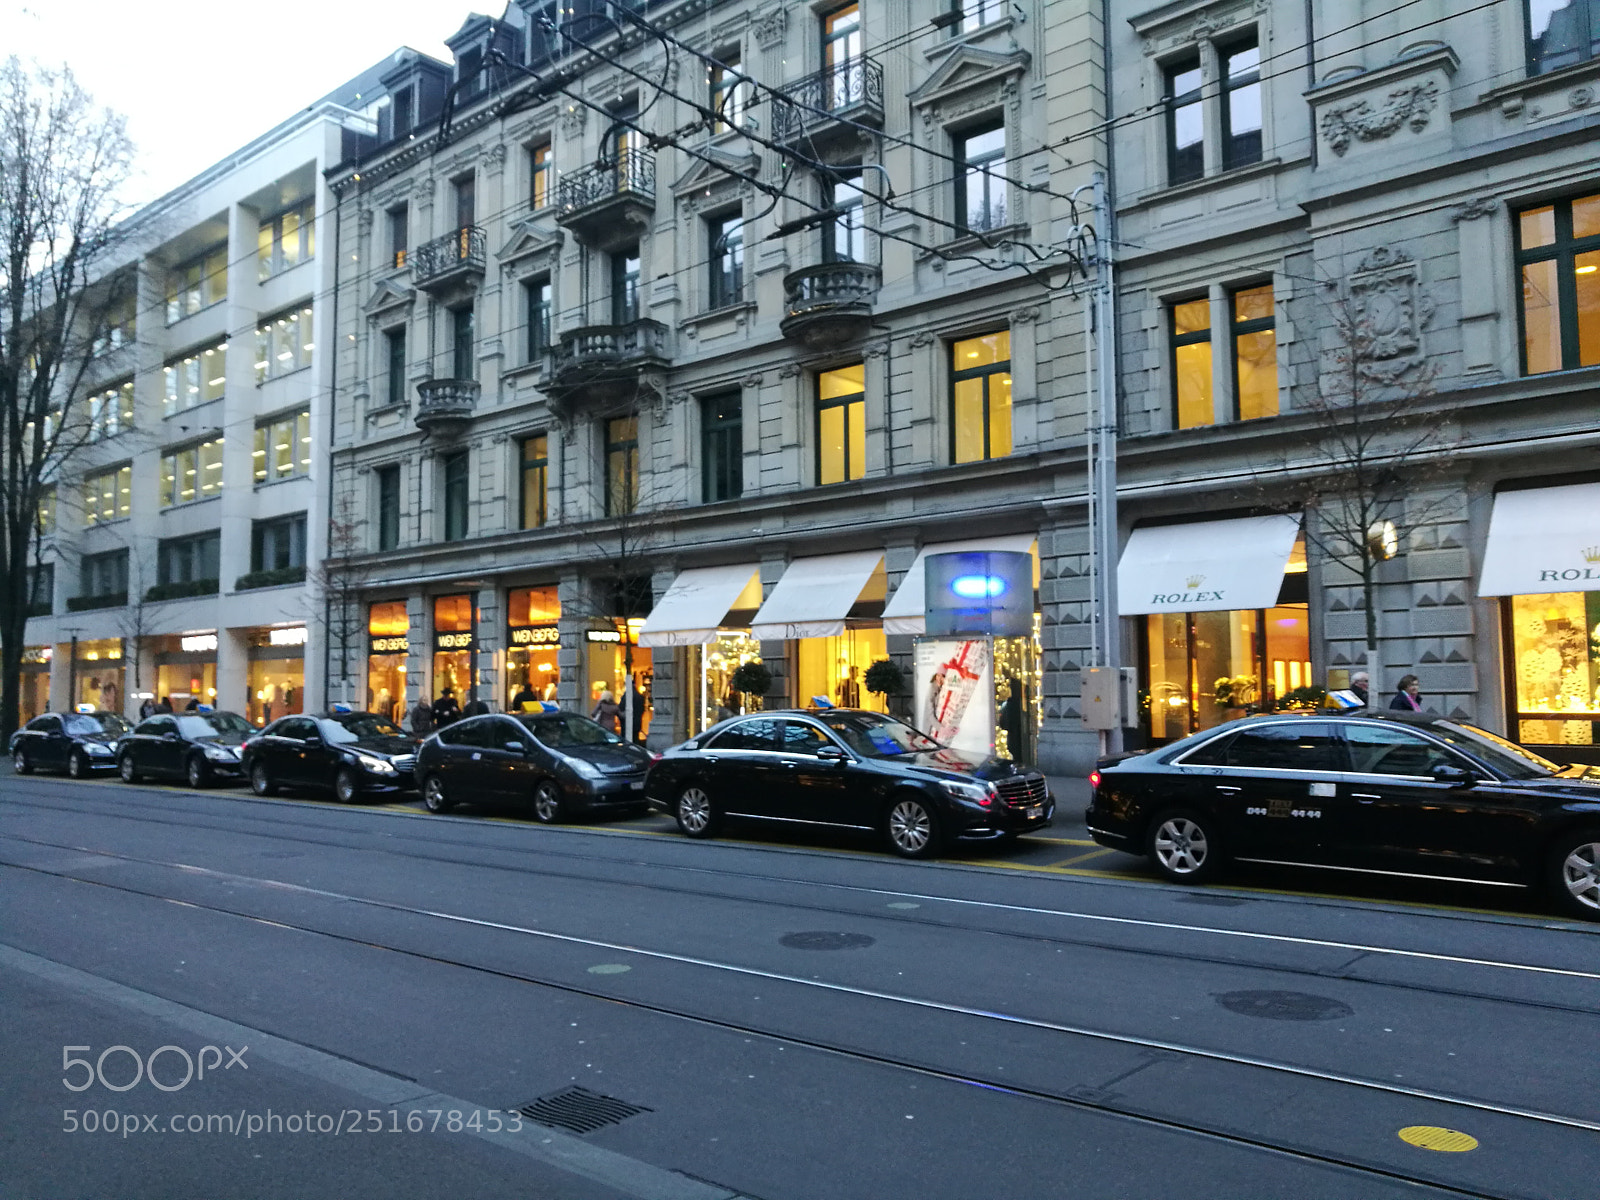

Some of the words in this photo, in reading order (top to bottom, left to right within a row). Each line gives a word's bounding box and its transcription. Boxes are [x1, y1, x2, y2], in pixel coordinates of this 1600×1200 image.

[1151, 590, 1226, 604] ROLEX
[512, 627, 560, 643] WEINBERG
[786, 624, 810, 638] Dior
[667, 632, 688, 646] Dior
